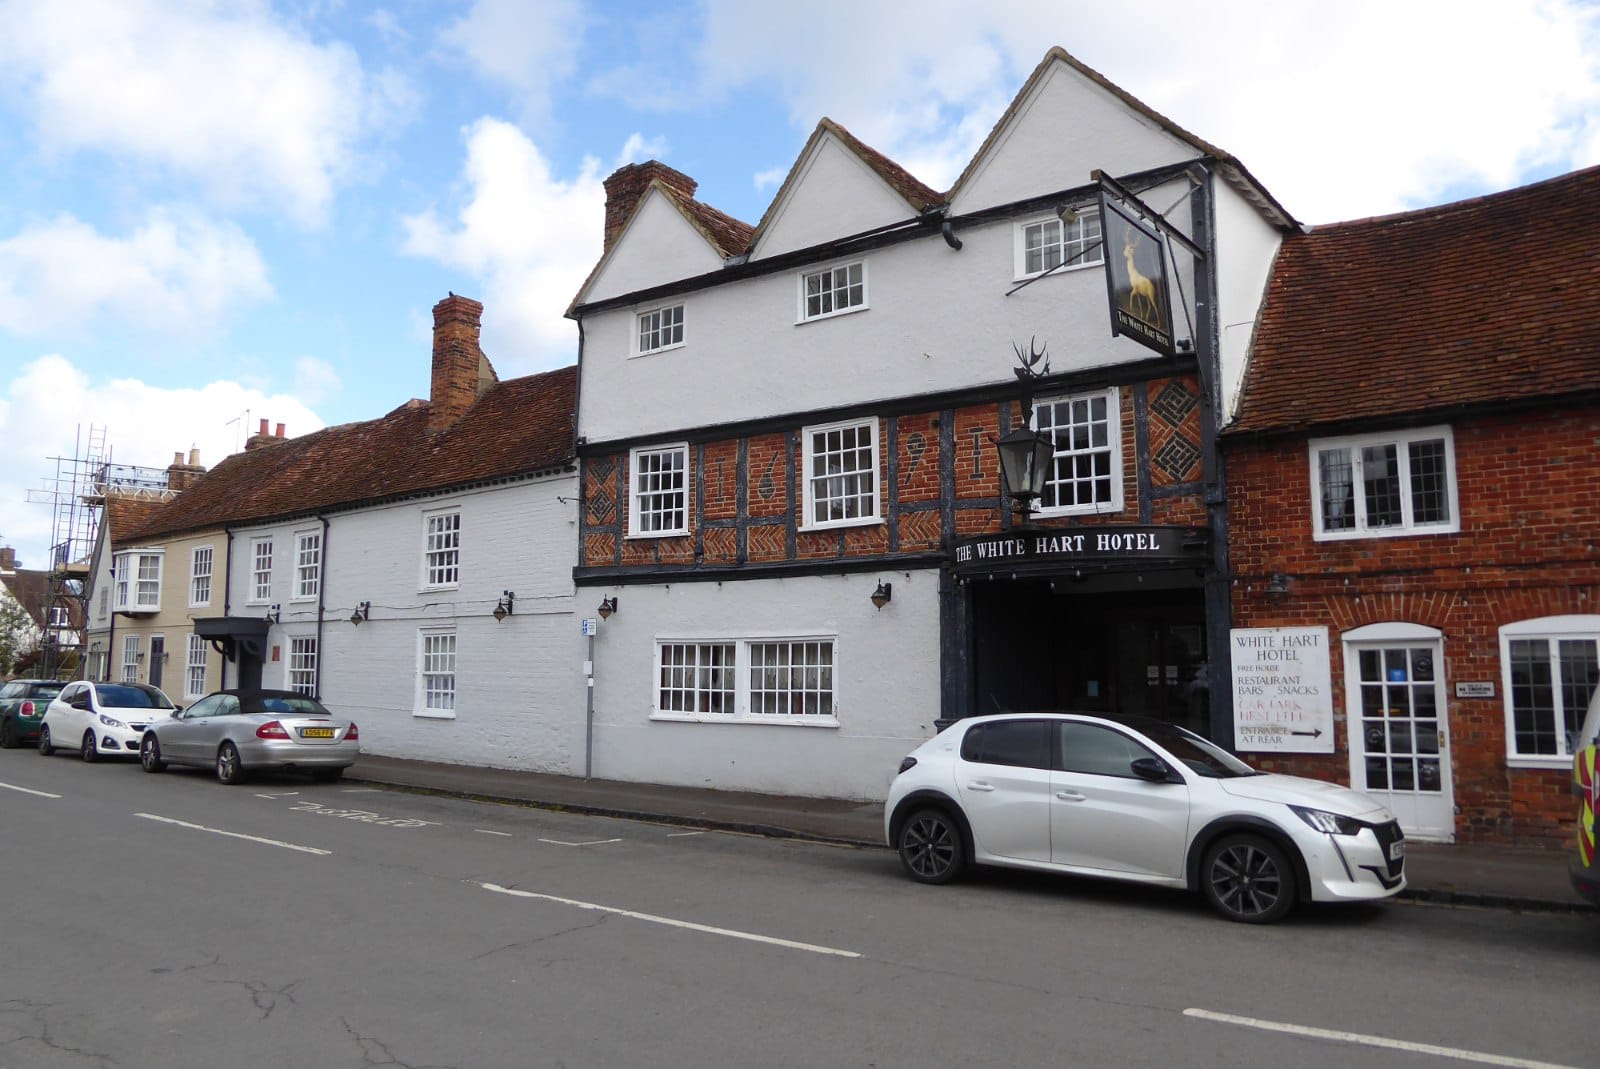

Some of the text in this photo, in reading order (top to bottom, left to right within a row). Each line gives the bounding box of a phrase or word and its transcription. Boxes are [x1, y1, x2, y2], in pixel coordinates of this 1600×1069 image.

[955, 533, 1160, 563] THE WHITE HART HOTEL
[1236, 634, 1321, 648] WHITE HART
[1257, 649, 1300, 661] HOTEL
[1237, 664, 1279, 672] FREE HOUSE
[1238, 675, 1301, 686] RESTAURANT
[1238, 686, 1319, 696] BARS SNACKS
[1239, 700, 1264, 710] CR
[1240, 726, 1288, 736] ENTRANCE
[1242, 735, 1282, 744] AT REAR
